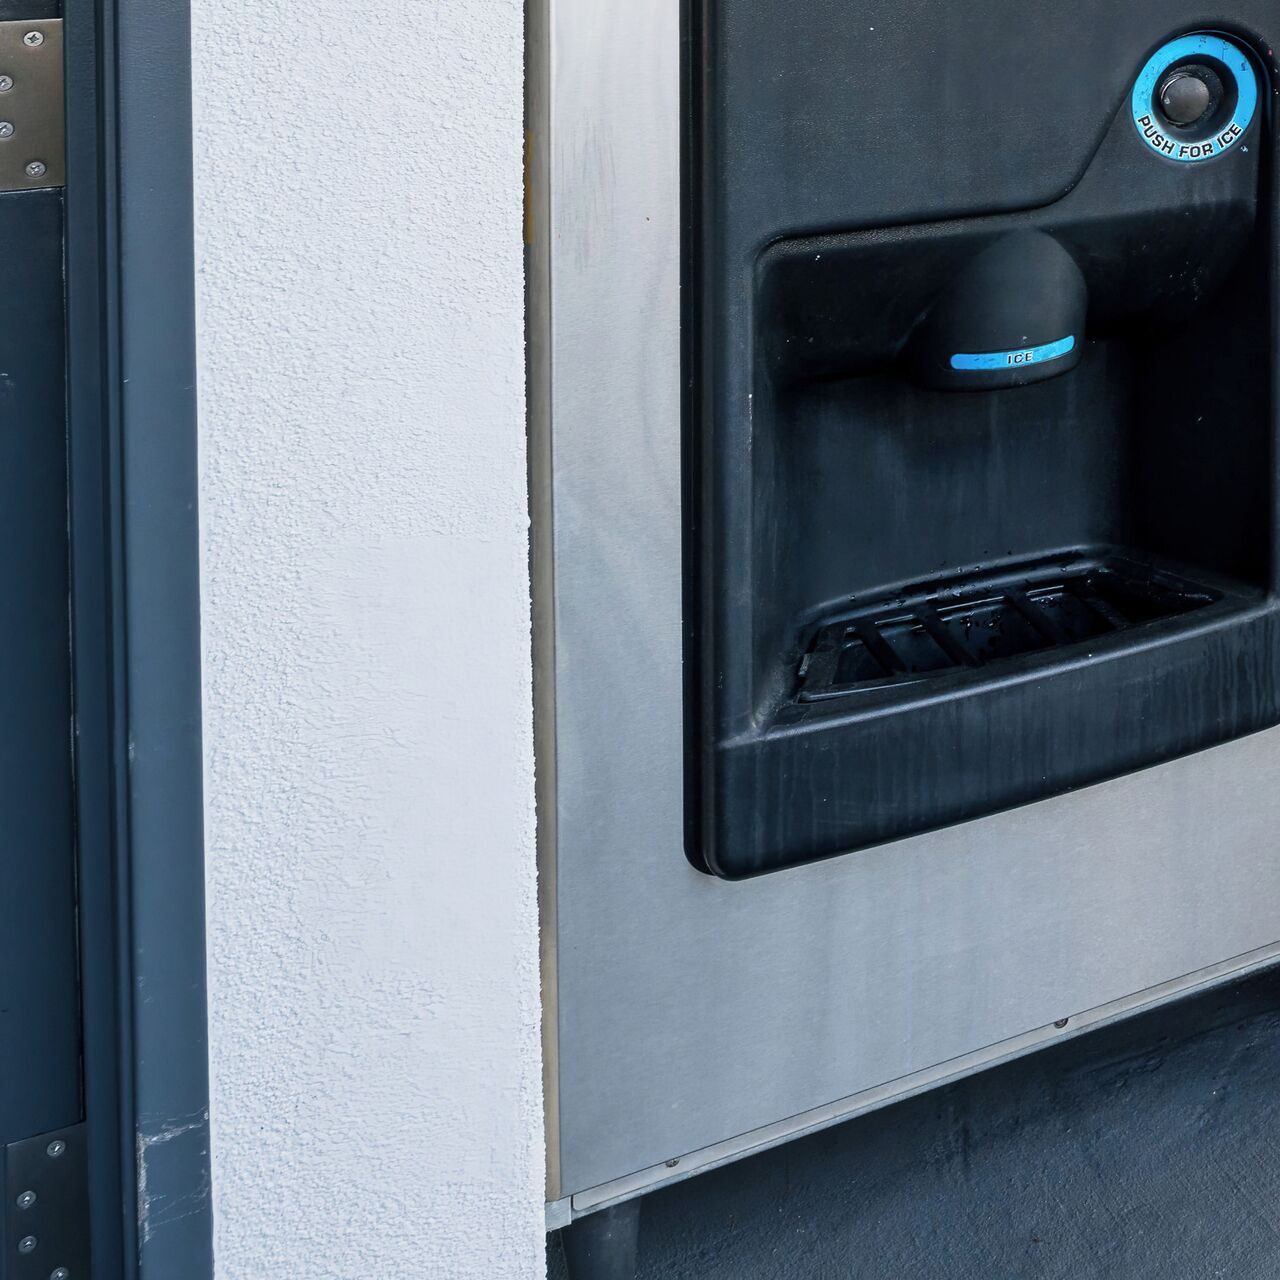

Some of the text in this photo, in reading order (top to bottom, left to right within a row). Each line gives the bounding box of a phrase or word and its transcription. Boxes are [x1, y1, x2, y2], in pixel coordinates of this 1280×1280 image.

[1137, 115, 1243, 158] PUSH FOR ICE
[1007, 352, 1033, 365] ICE
